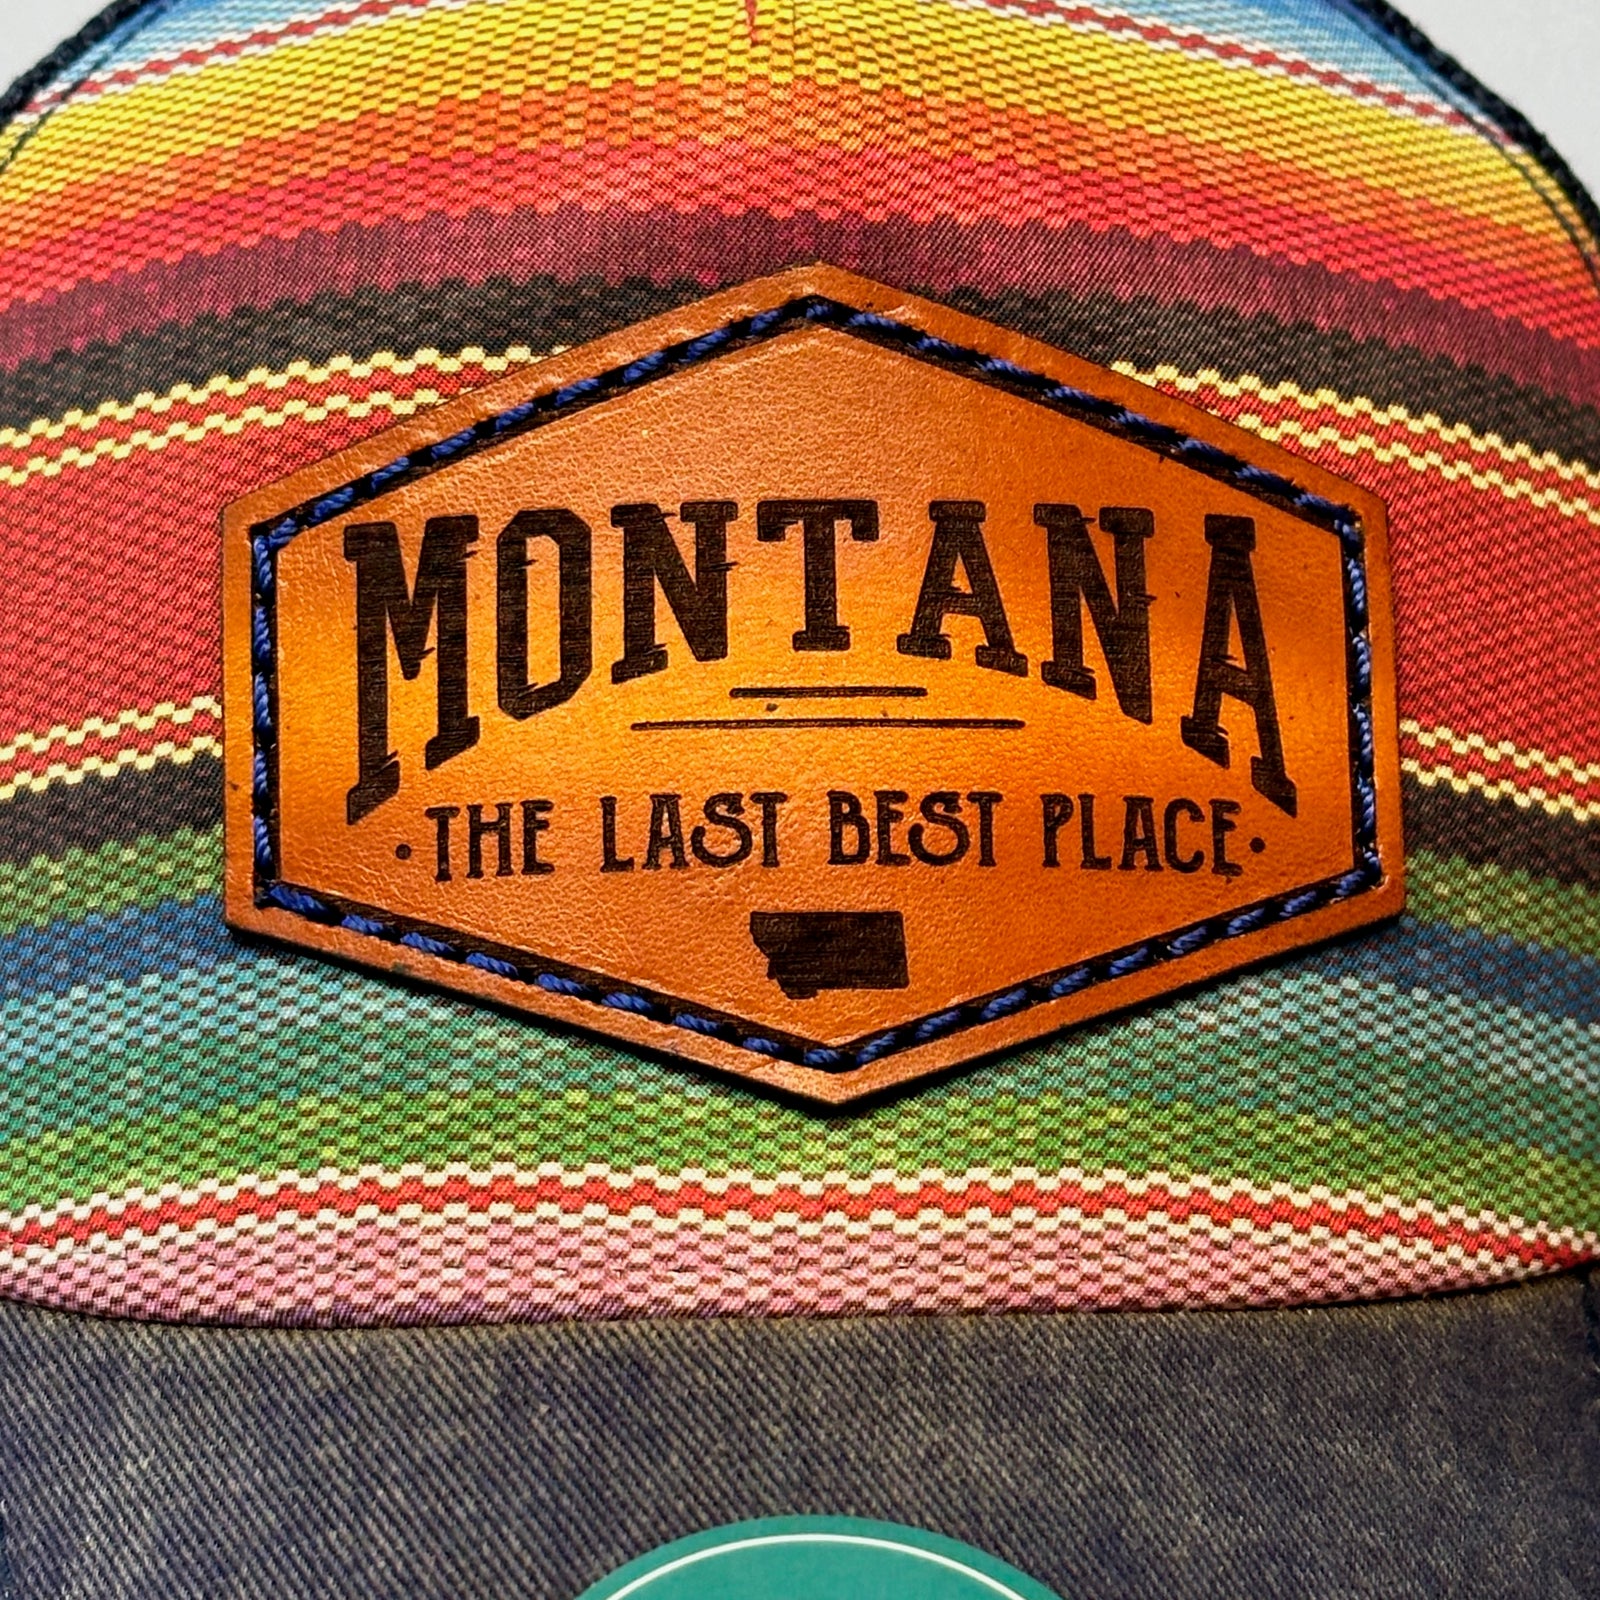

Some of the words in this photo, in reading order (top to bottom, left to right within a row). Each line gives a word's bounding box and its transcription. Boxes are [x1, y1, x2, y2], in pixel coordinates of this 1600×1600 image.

[343, 499, 1298, 826] MONTANA
[425, 799, 555, 882] THE
[600, 792, 788, 873] LAST
[827, 790, 1003, 867] BEST
[1039, 793, 1243, 876] PLACE
